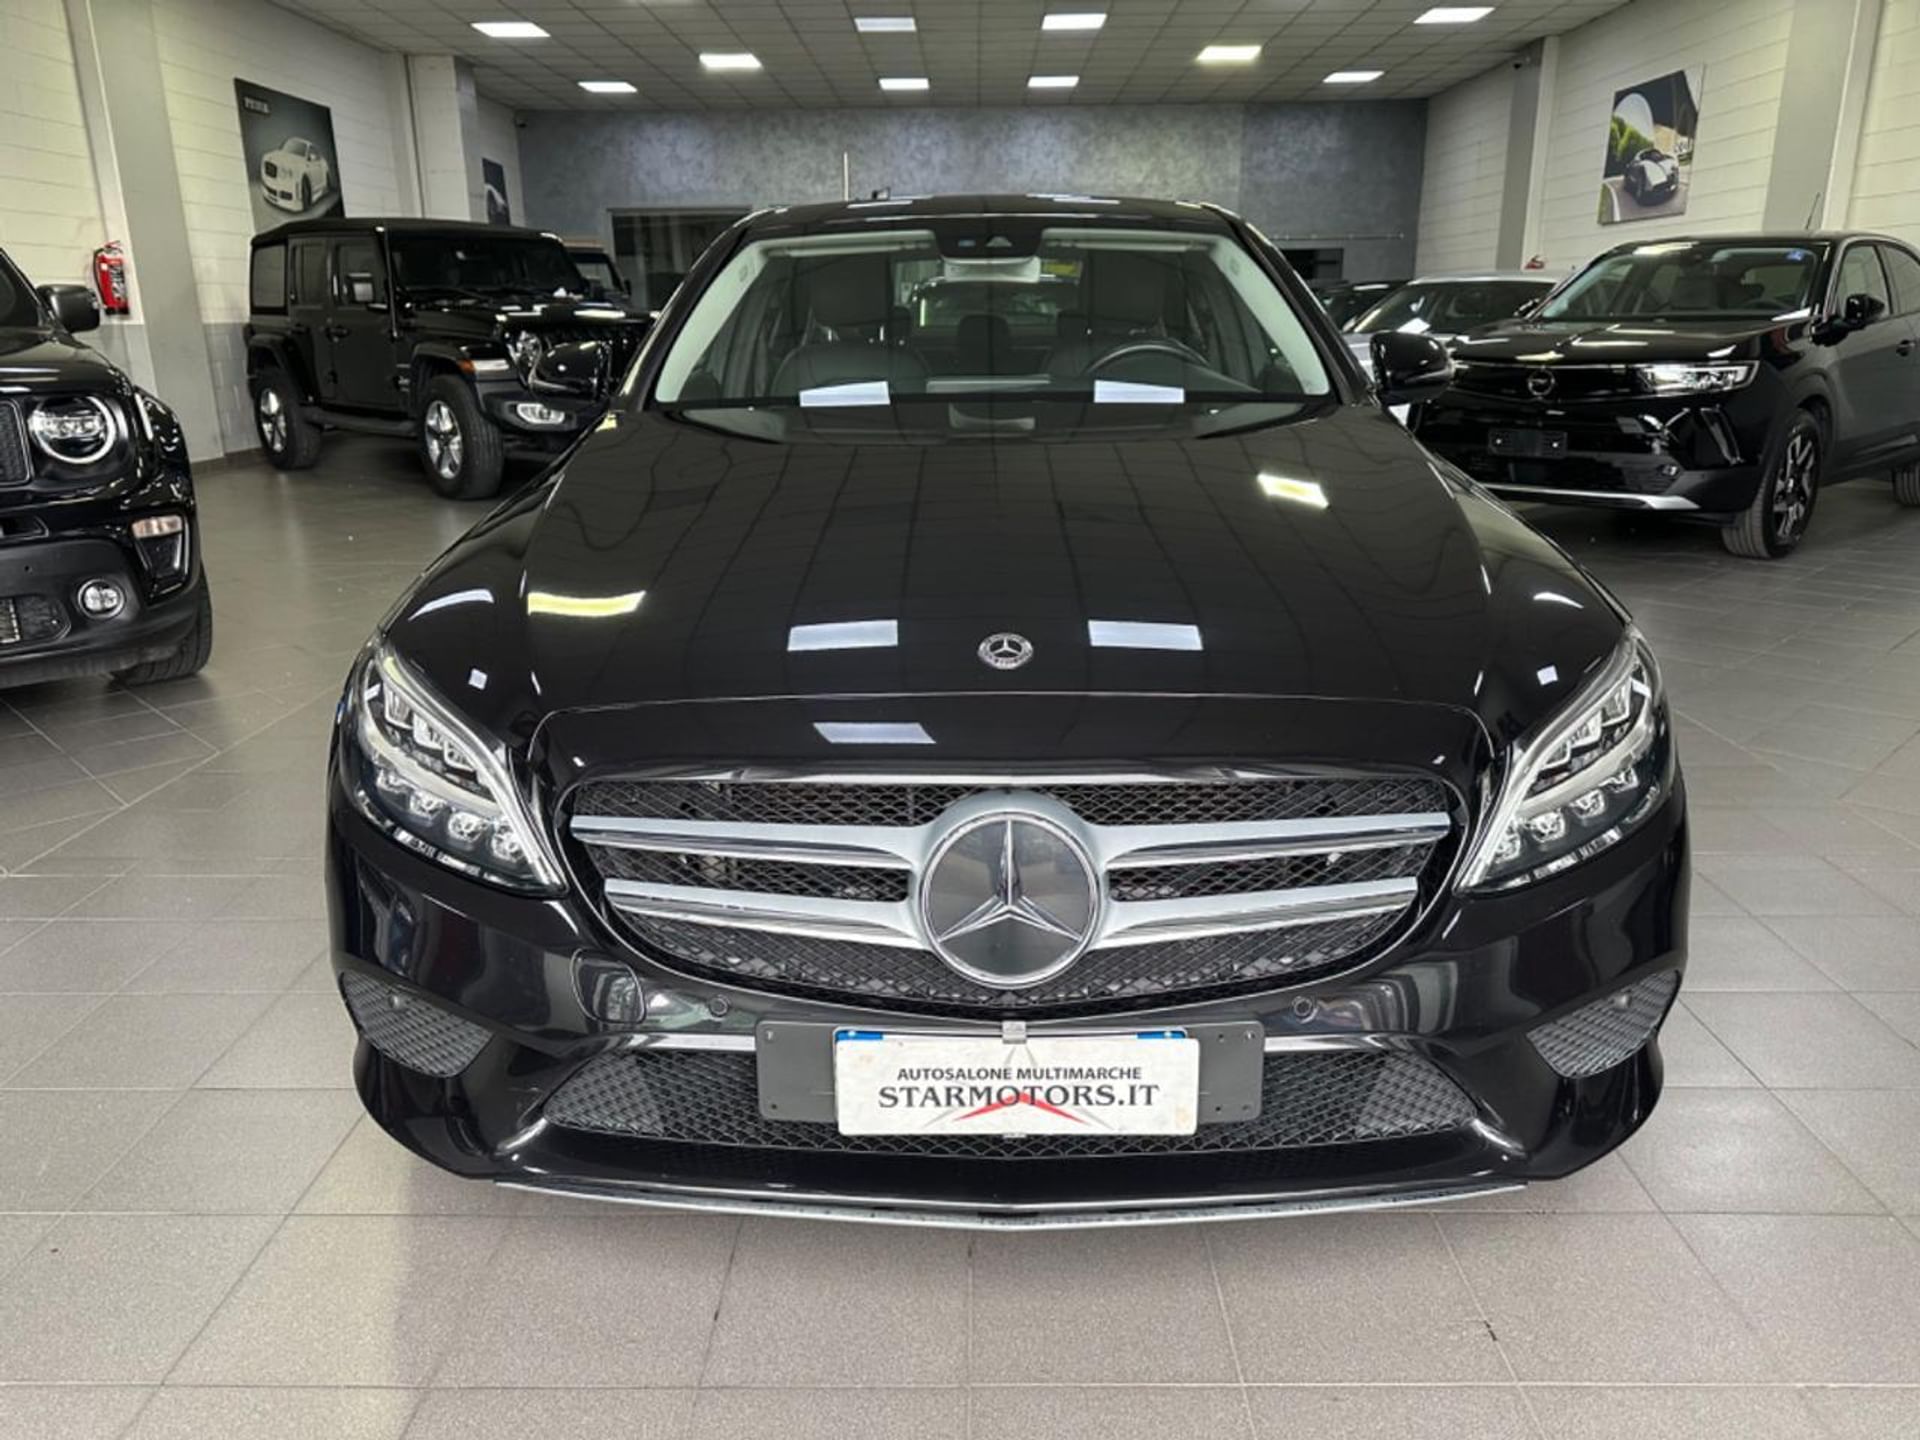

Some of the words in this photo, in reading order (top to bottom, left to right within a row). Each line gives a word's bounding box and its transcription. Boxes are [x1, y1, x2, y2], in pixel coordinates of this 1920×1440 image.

[897, 1067, 1012, 1081] AUTOSALONE
[1016, 1066, 1142, 1080] MULTIMARCHE
[878, 1084, 1160, 1108] STARMOTORS.IT
